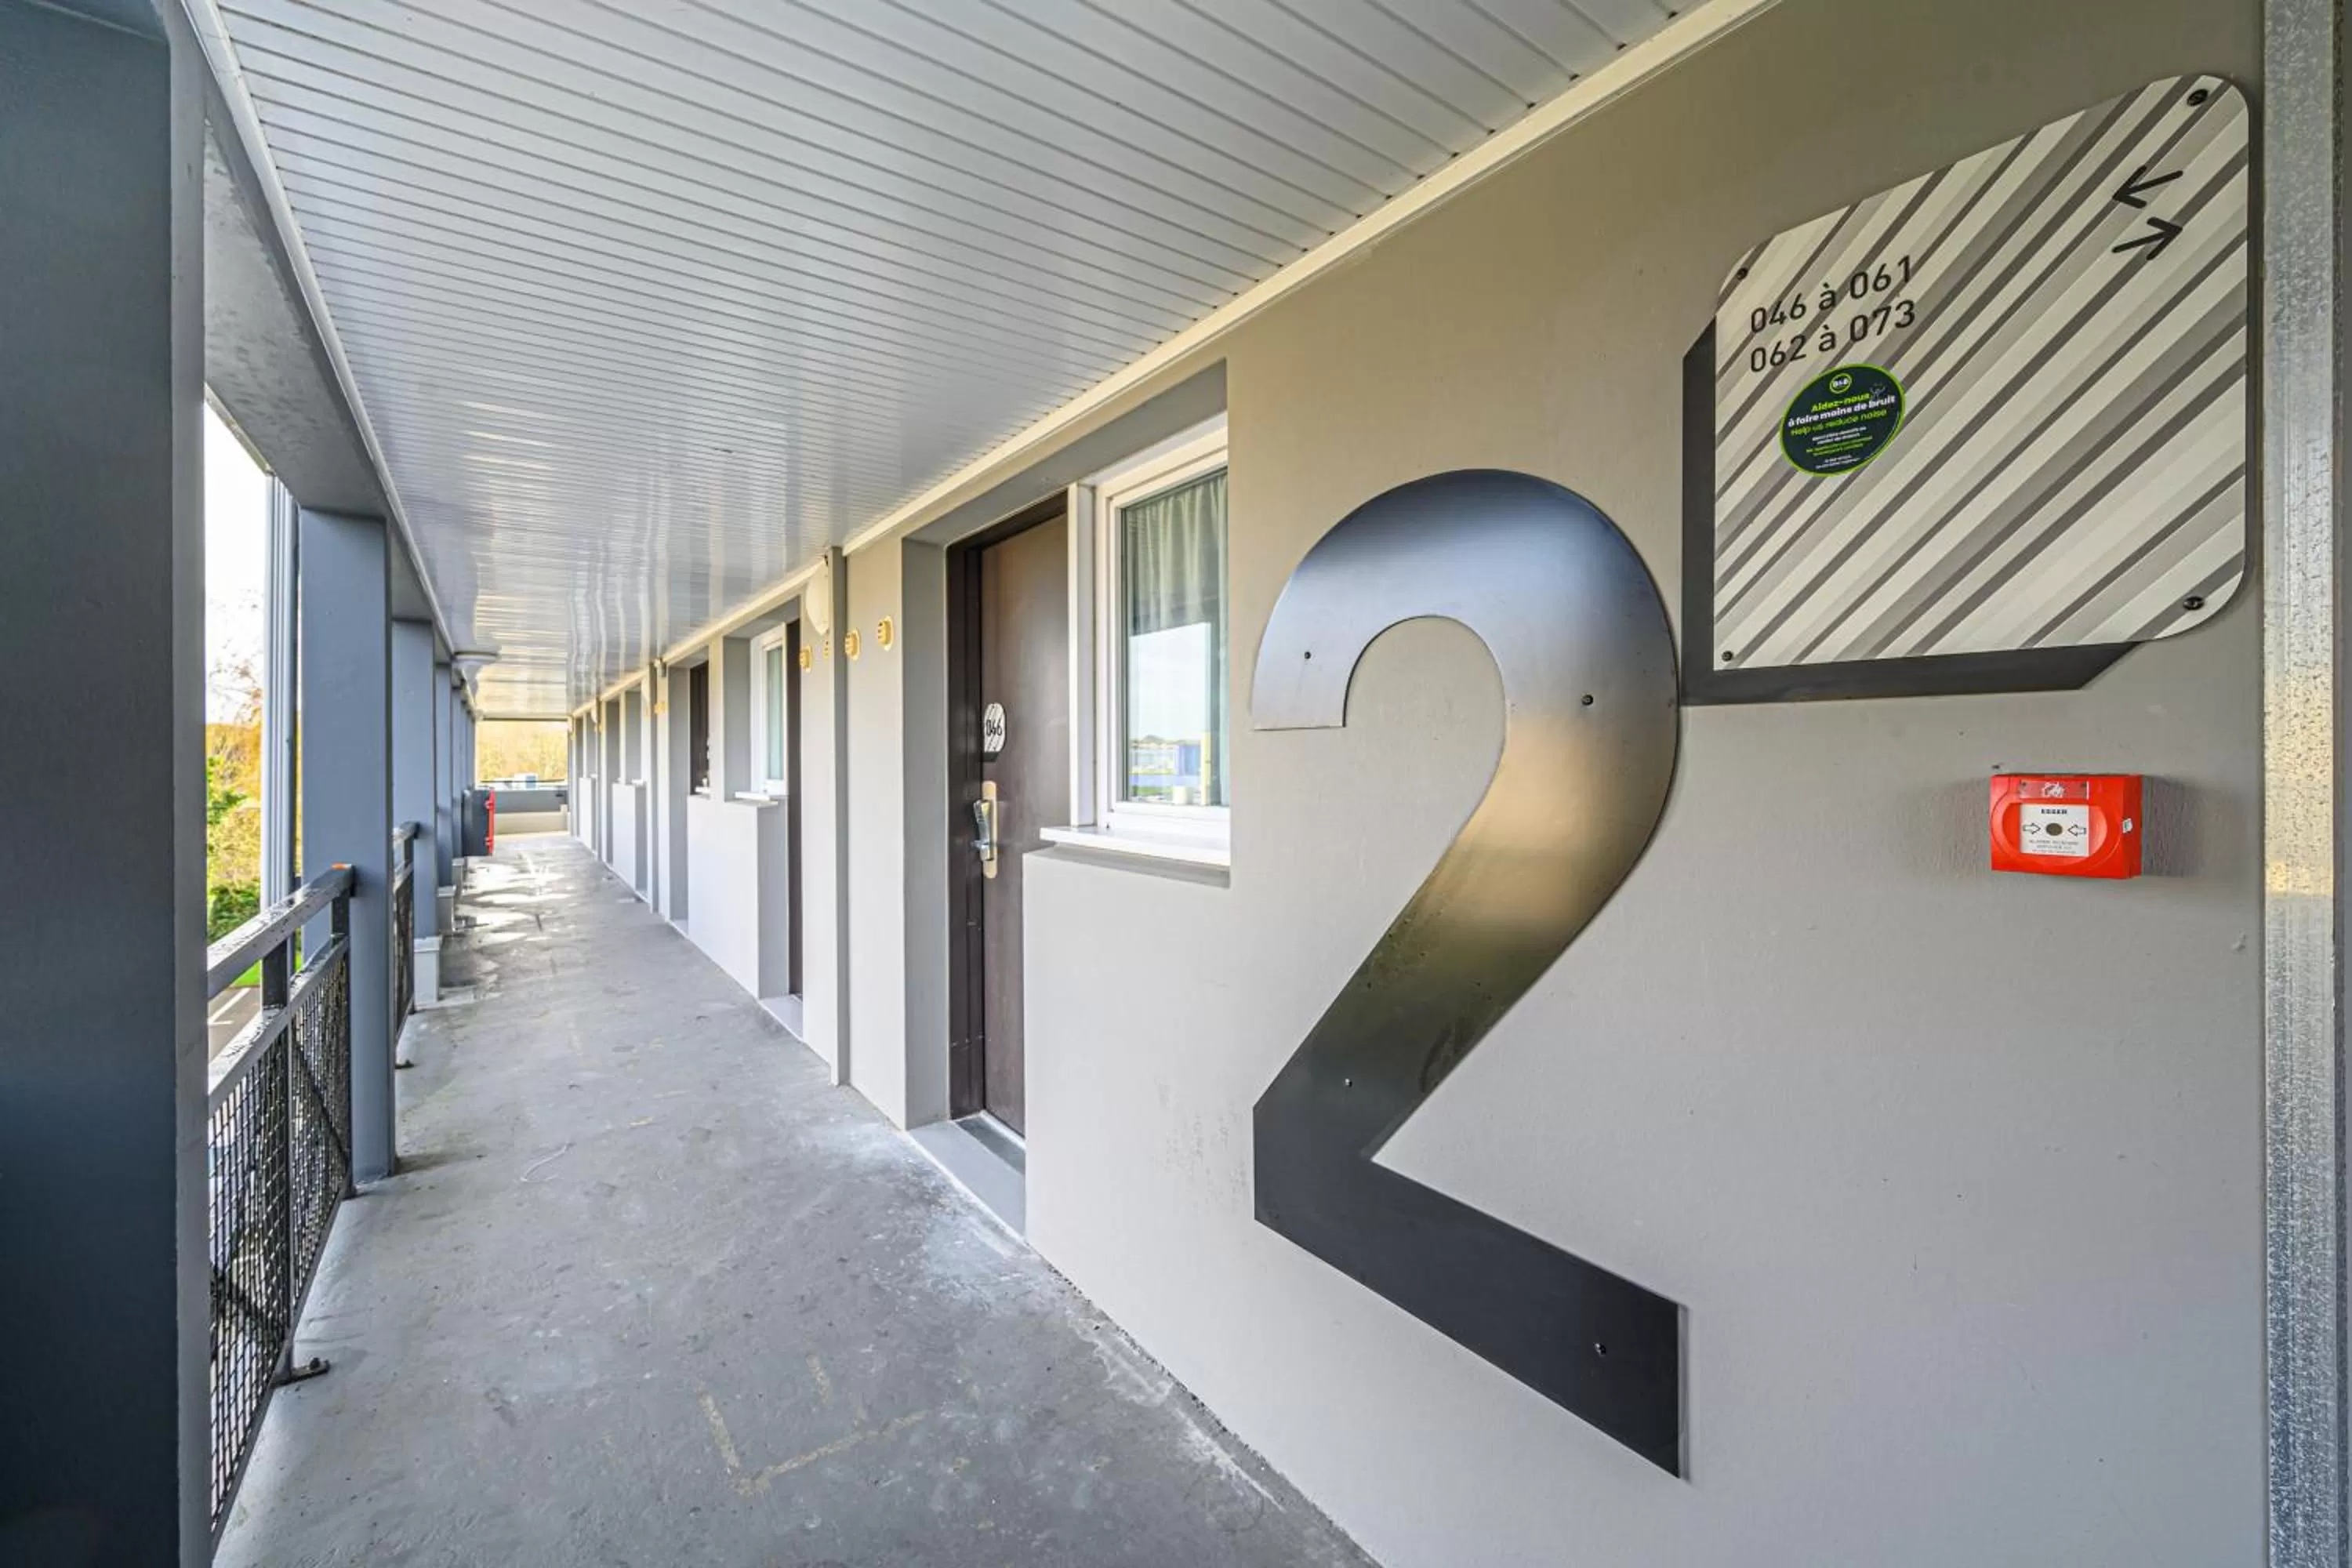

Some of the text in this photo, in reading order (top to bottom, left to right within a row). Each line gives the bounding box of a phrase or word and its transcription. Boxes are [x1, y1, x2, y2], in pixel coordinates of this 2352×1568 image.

[1751, 255, 1911, 333] 046 à 061
[1751, 299, 1915, 372] 062 à 073
[1796, 413, 1820, 426] faire
[1820, 407, 1853, 419] moins
[1853, 401, 1867, 412] de
[1868, 394, 1896, 408] bruit
[1811, 393, 1871, 413] Aidez-nous
[1251, 468, 1681, 1478] 2
